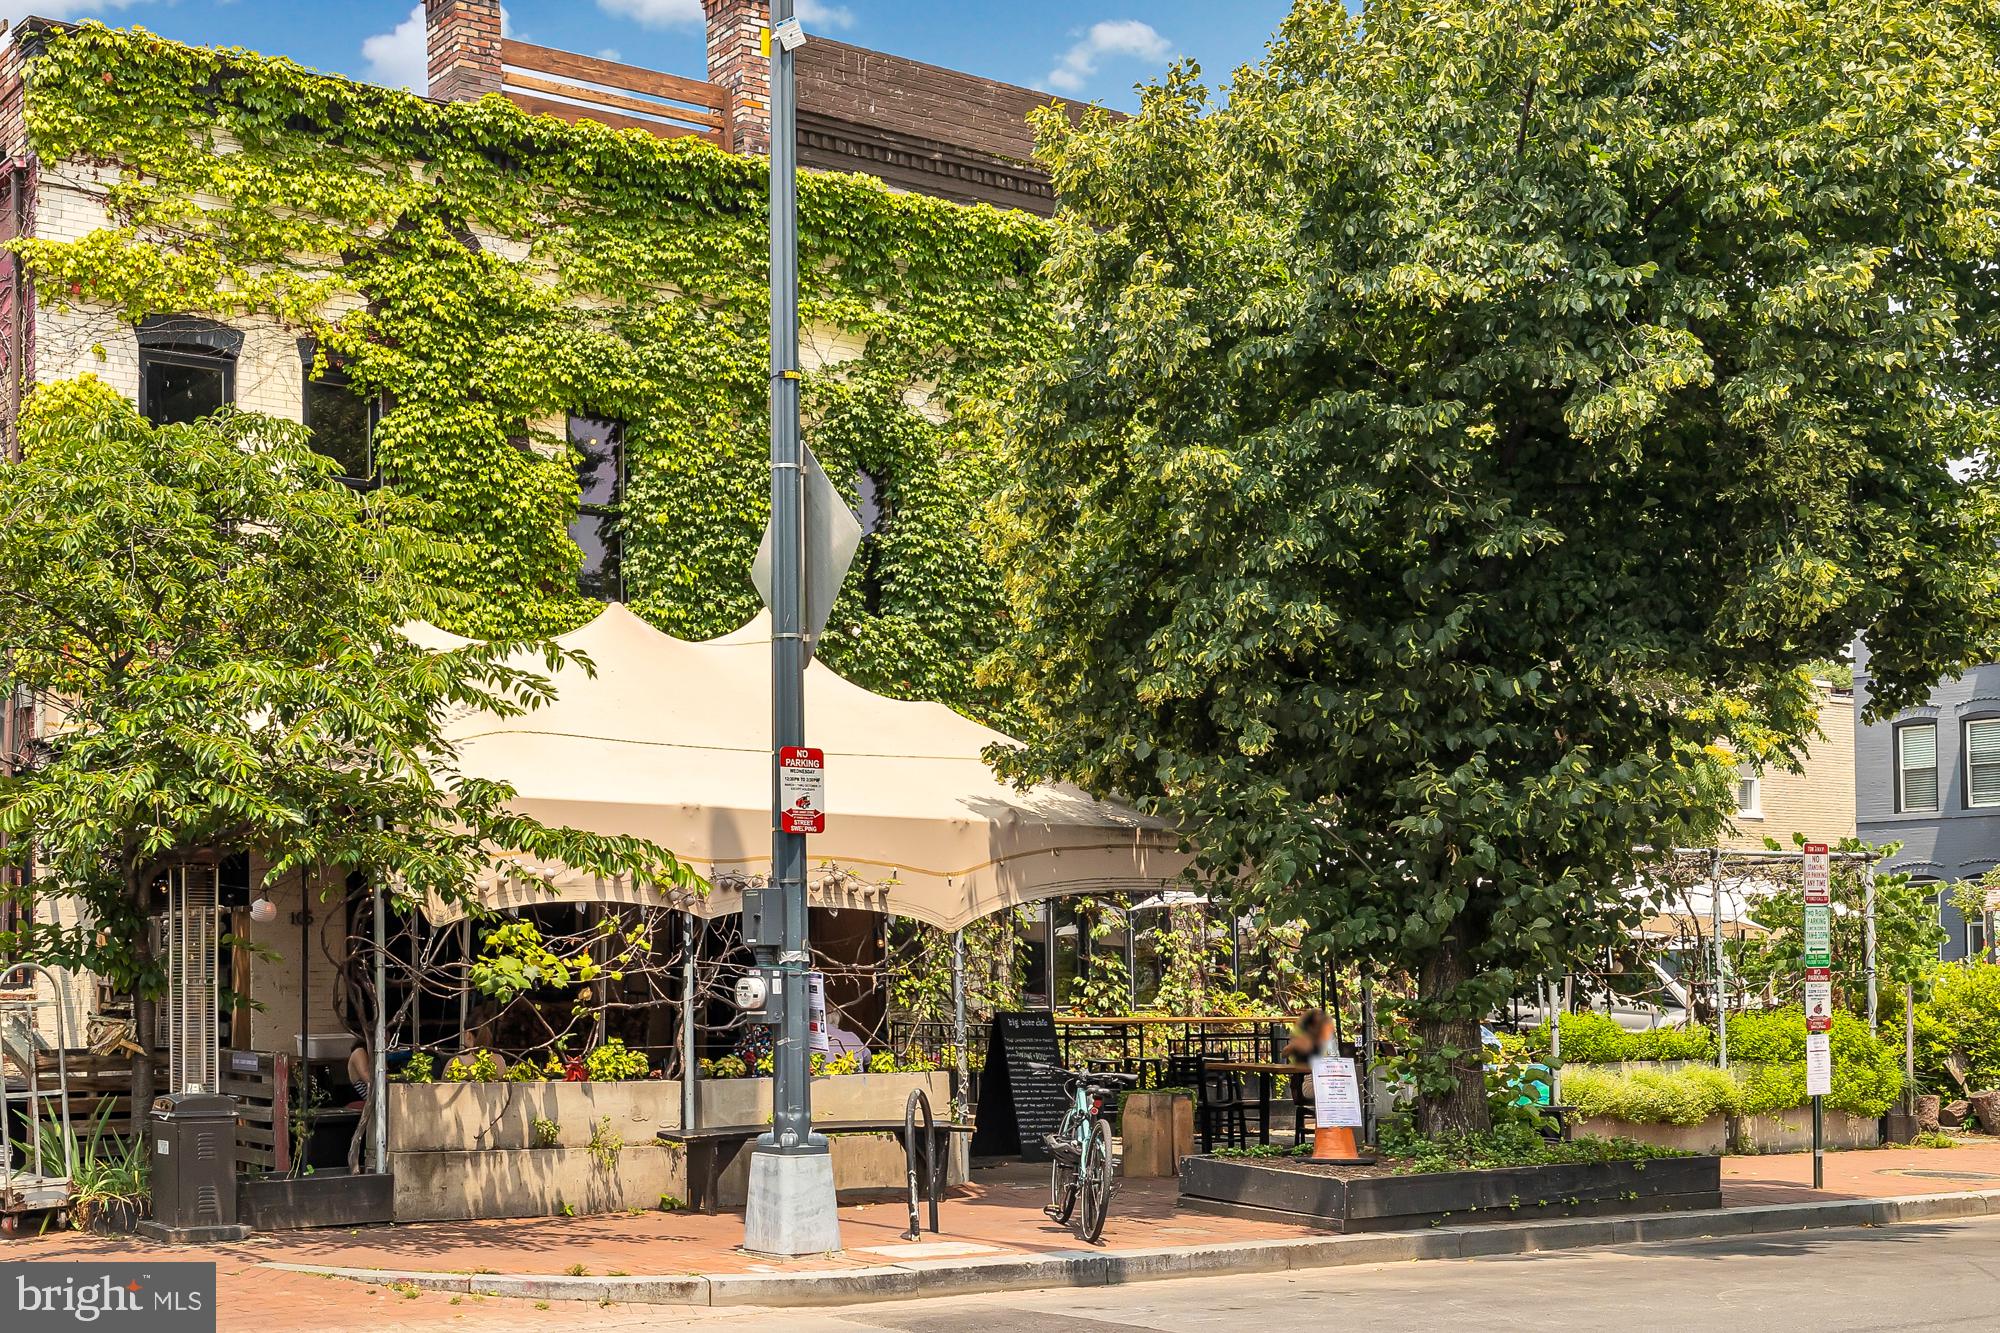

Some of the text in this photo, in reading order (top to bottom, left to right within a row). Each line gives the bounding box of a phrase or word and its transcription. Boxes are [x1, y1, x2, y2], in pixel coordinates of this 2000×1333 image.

[796, 750, 808, 758] NO
[785, 758, 820, 768] PARKING
[1807, 879, 1826, 887] ANY TIME
[1807, 917, 1827, 925] PARKING
